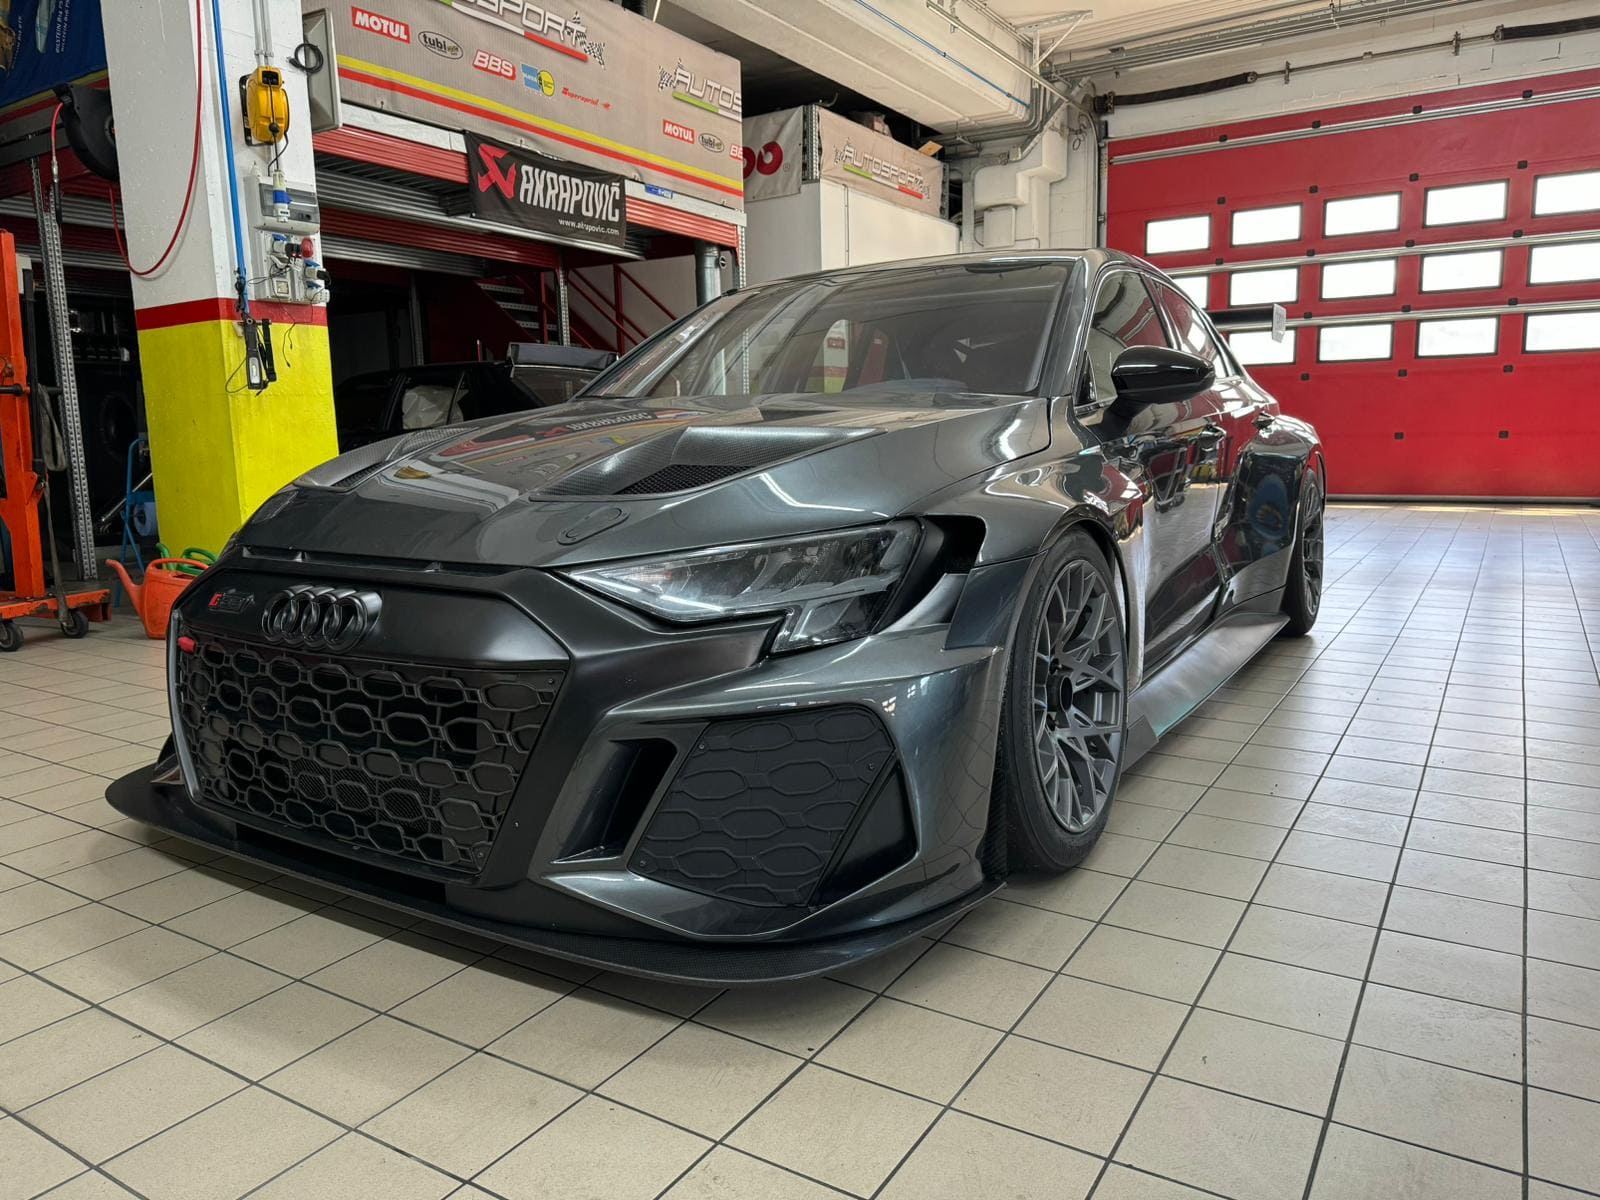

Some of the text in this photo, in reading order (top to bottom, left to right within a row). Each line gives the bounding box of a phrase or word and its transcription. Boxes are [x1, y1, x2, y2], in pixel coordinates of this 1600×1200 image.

[355, 10, 407, 40] MOTUL
[474, 50, 514, 77] BBS
[664, 122, 694, 141] MOTUL
